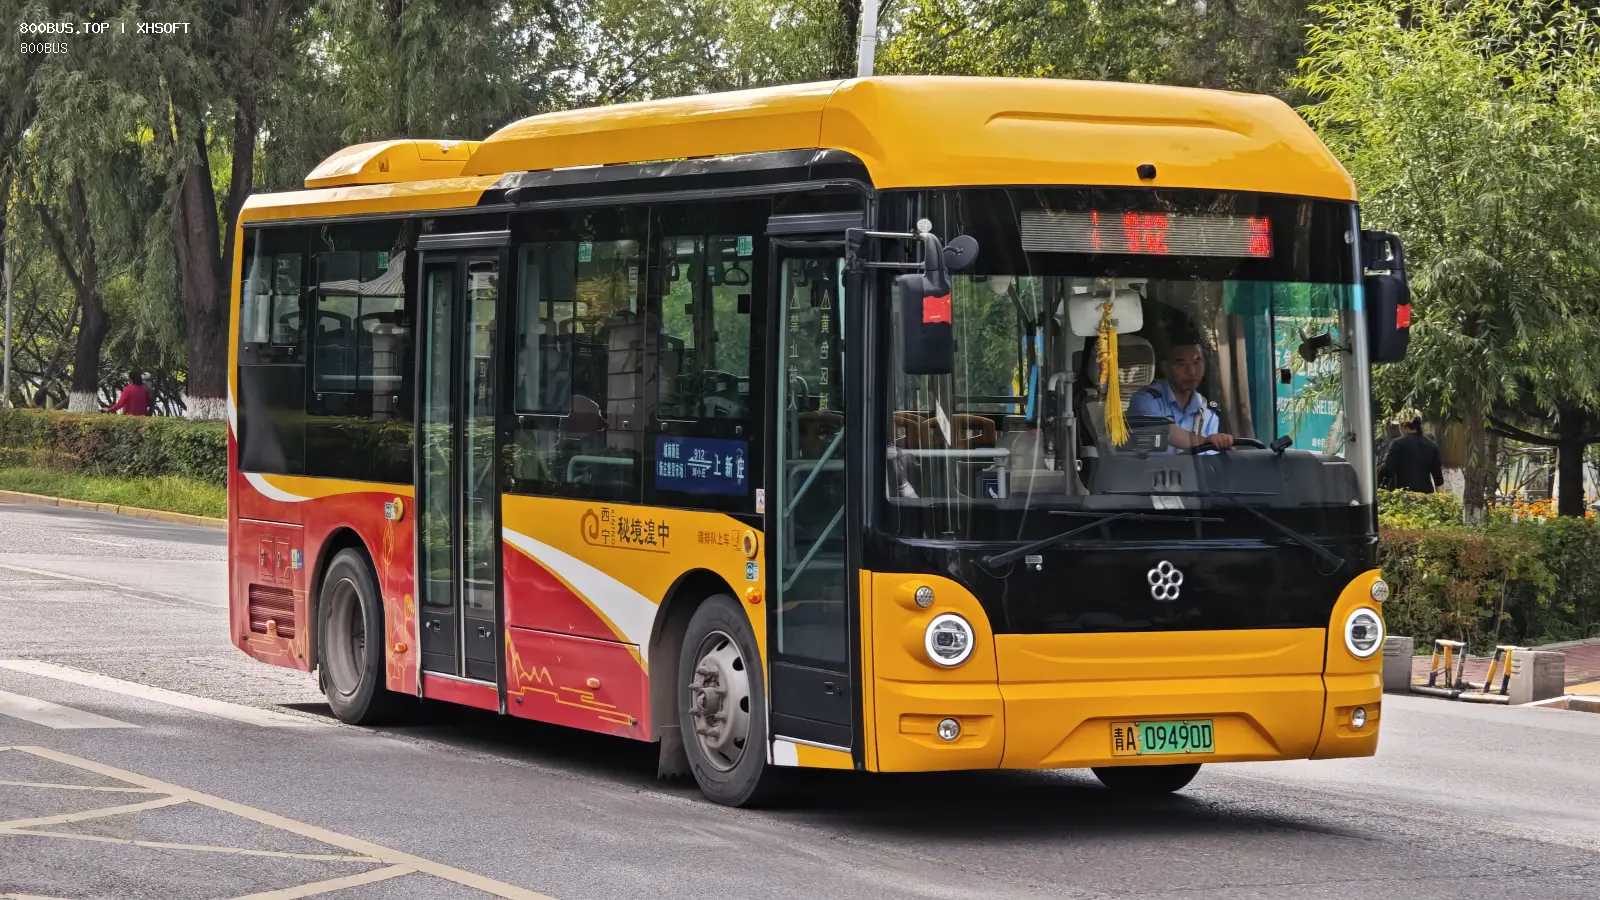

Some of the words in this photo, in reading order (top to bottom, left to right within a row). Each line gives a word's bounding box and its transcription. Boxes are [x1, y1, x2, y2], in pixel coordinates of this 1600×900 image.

[693, 448, 705, 460] 912
[601, 507, 610, 545] 西宁
[617, 516, 670, 548] 秘境湟中
